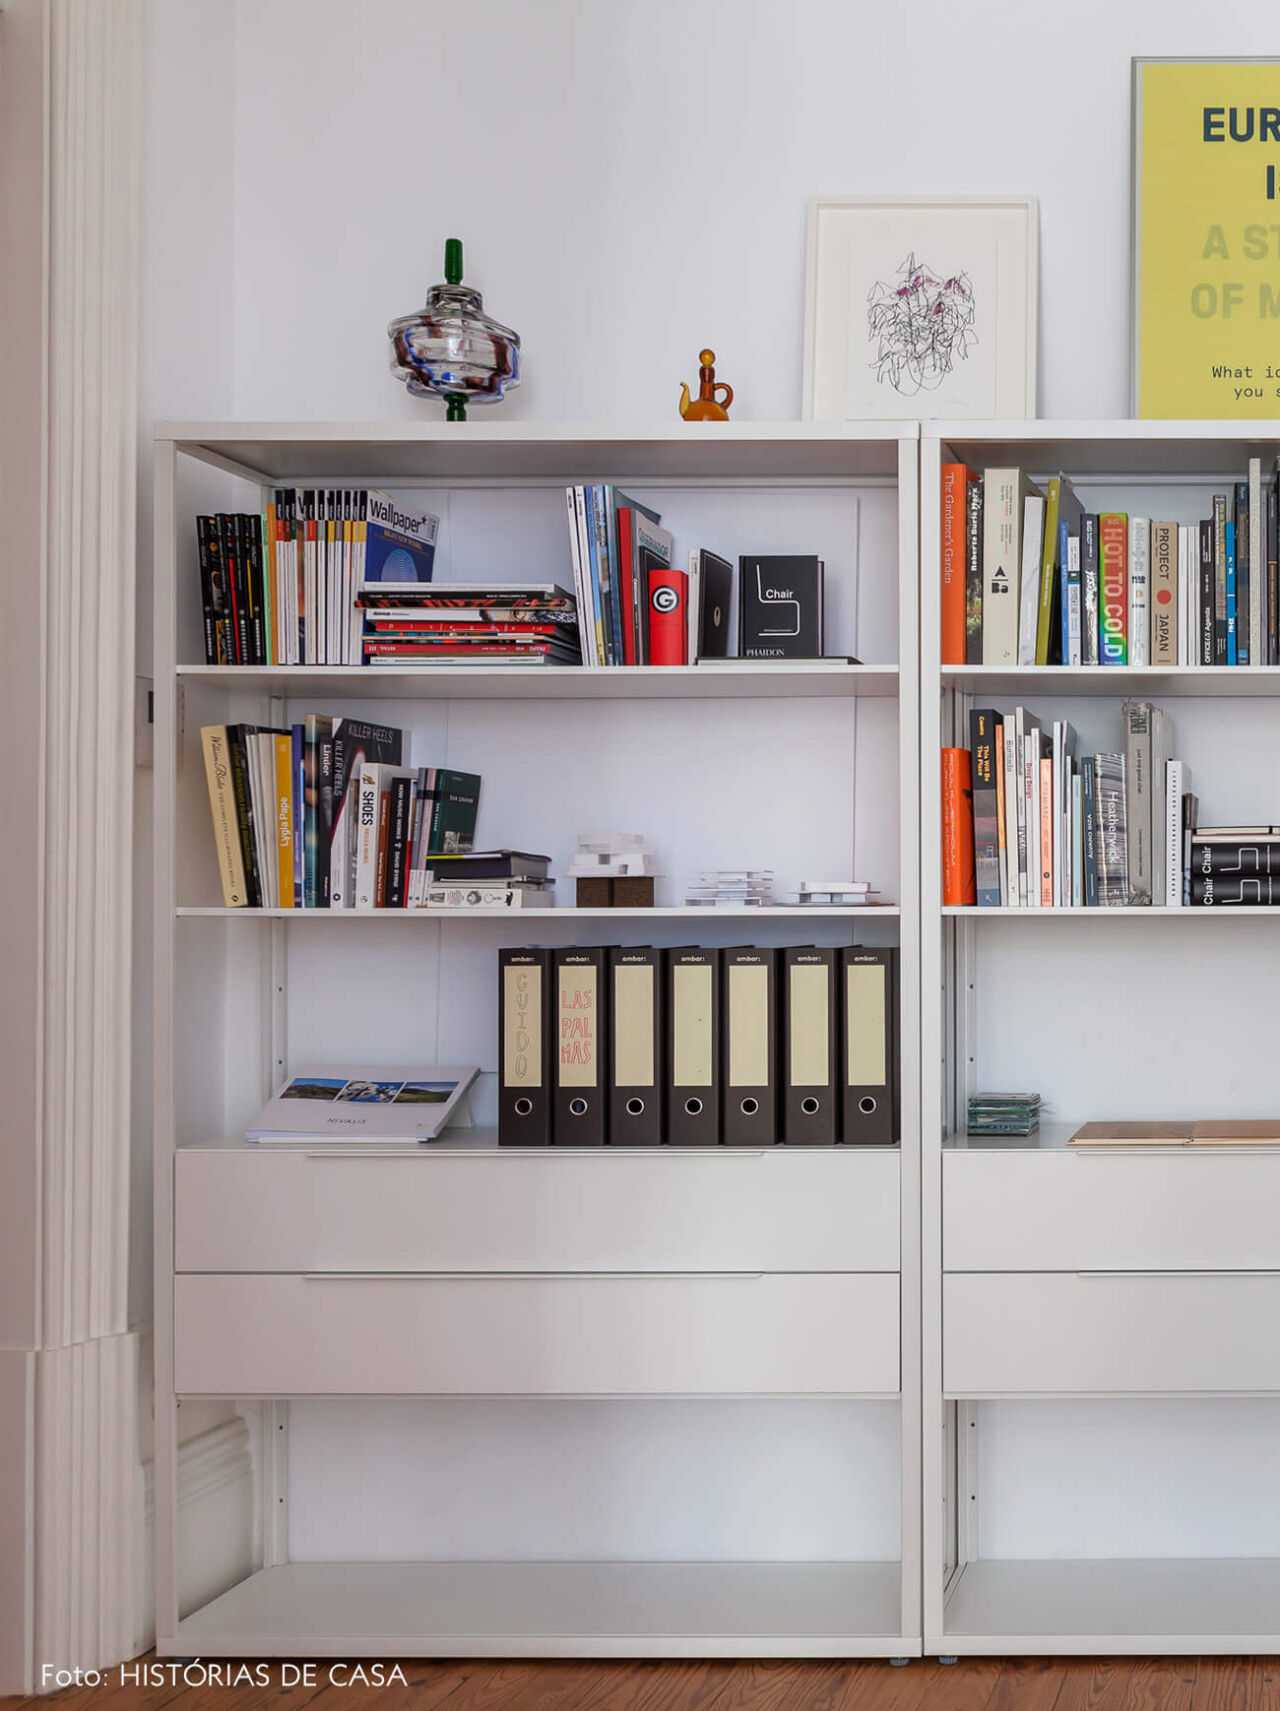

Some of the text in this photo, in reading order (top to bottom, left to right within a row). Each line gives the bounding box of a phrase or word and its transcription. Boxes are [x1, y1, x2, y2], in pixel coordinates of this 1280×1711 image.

[1202, 225, 1230, 260] A
[1190, 283, 1244, 320] OF
[1212, 366, 1253, 379] What
[1234, 386, 1263, 400] you
[943, 473, 954, 583] The Gardener's Garden
[970, 512, 979, 535] Burle
[970, 536, 978, 571] Roberto
[1104, 528, 1122, 567] HOT
[766, 589, 794, 599] Chair
[1104, 573, 1122, 596] TO
[1159, 528, 1169, 651] PROJECT JAPAN
[1104, 605, 1123, 657] COLD
[1204, 606, 1212, 631] Agenda
[746, 648, 785, 657] PHAIDON
[348, 724, 394, 744] KILLER HEELS
[322, 744, 332, 775] Linder
[333, 740, 344, 796] KILLER HEELS
[984, 773, 990, 782] Be
[278, 796, 291, 847] Lygia Pape
[362, 791, 374, 826] SHOES
[1108, 792, 1120, 864] Heatherwick
[1202, 846, 1212, 874] Chair
[1204, 878, 1214, 905] Chair
[562, 989, 592, 1010] LAS
[516, 973, 529, 1080] GUIDO
[561, 1017, 592, 1039] PAL
[561, 1041, 591, 1065] MAS
